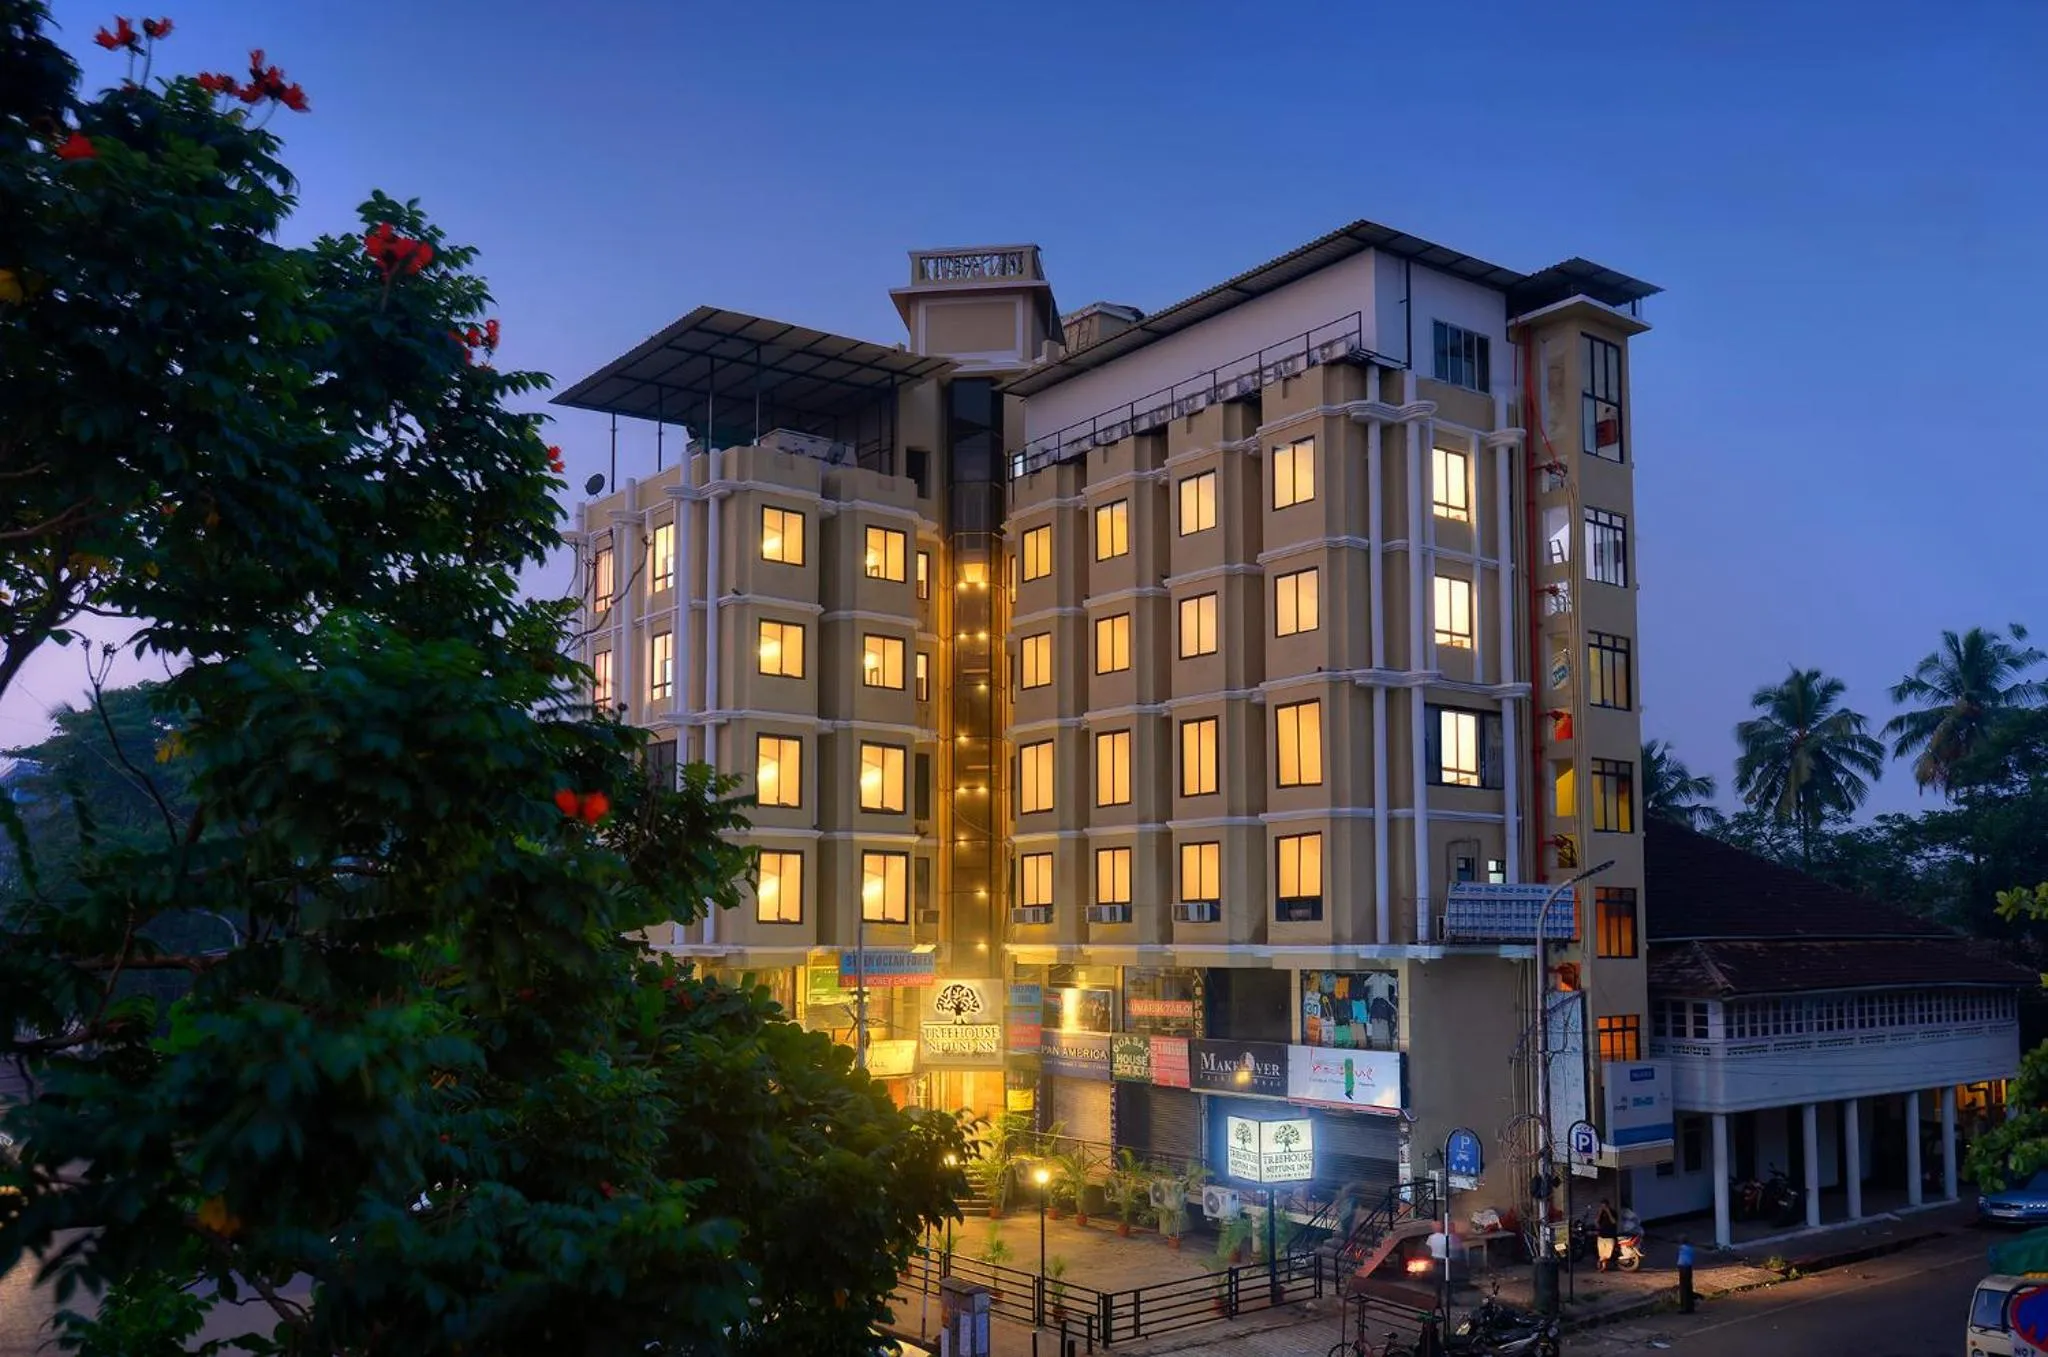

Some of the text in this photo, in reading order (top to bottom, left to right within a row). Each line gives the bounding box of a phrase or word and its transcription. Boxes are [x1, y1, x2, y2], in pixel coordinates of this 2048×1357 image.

[924, 1026, 1000, 1040] TREEHOUSE
[977, 1040, 996, 1053] INN
[1041, 1045, 1108, 1060] PAN AMERICA
[1116, 1053, 1148, 1066] HOUSE
[1461, 1136, 1470, 1149] P
[1578, 1134, 1590, 1151] P
[1262, 1152, 1313, 1165] TREEHOUSE
[1265, 1164, 1296, 1175] NEPTUNE
[1297, 1162, 1309, 1173] INN
